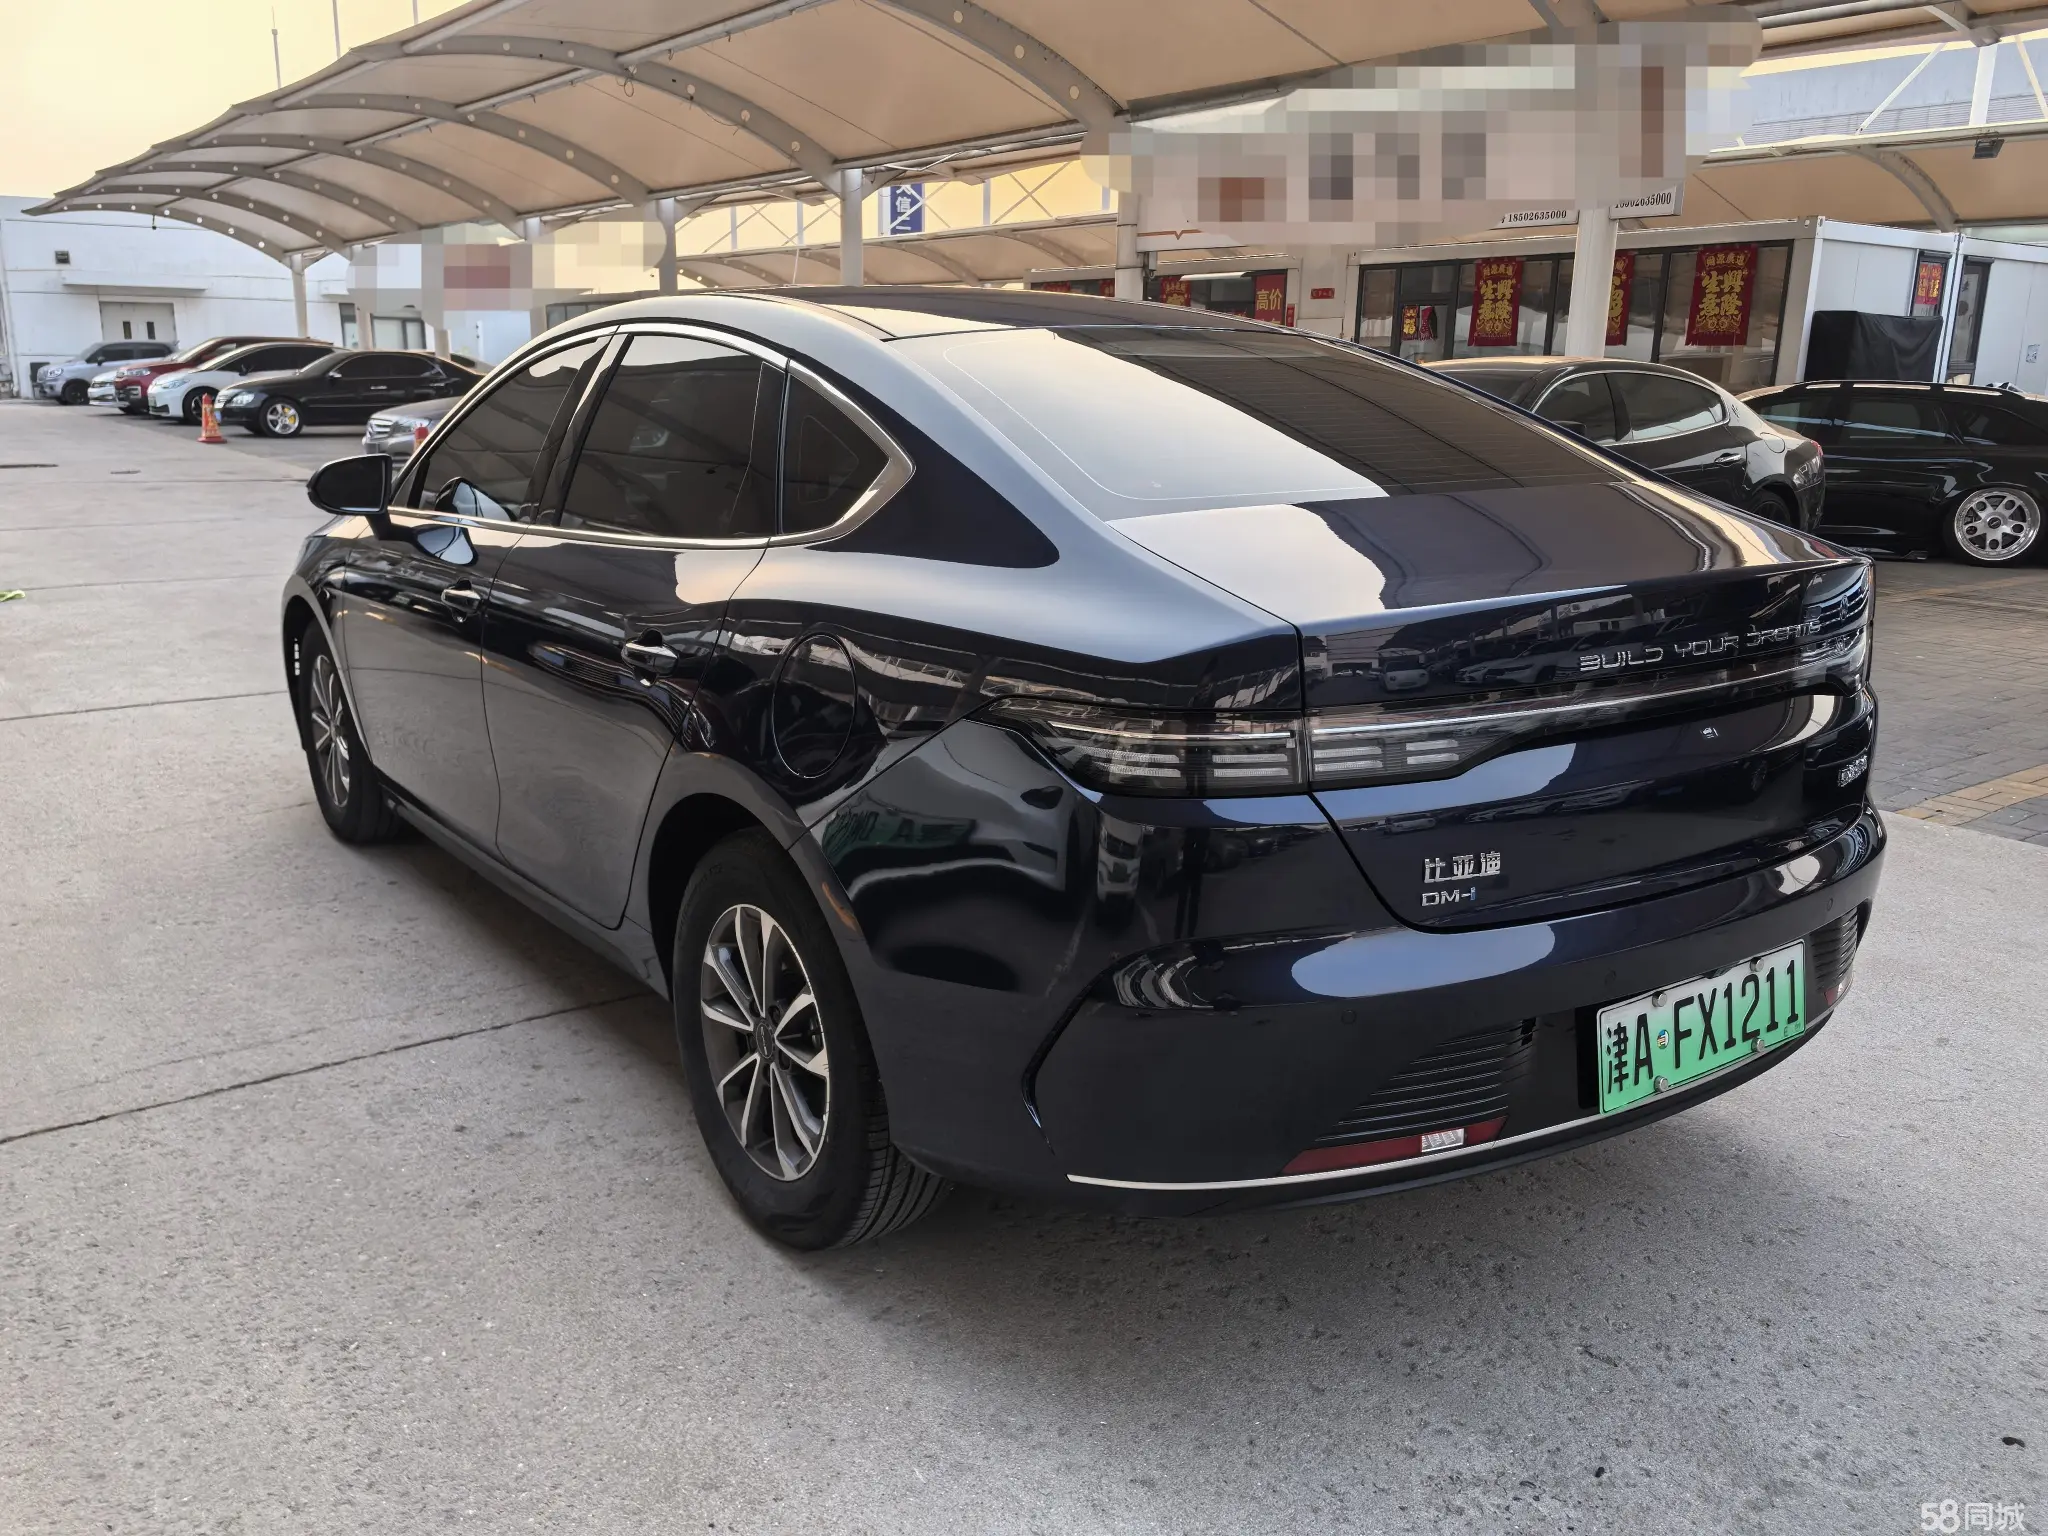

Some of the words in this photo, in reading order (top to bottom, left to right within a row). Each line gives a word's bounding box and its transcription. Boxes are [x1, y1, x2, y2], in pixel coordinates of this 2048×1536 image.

[1508, 210, 1567, 223] 18502635000
[1256, 288, 1283, 311] 高价
[1579, 647, 1664, 672] BUILD
[1674, 635, 1740, 658] YOUR
[1424, 851, 1501, 883] 比亚迪
